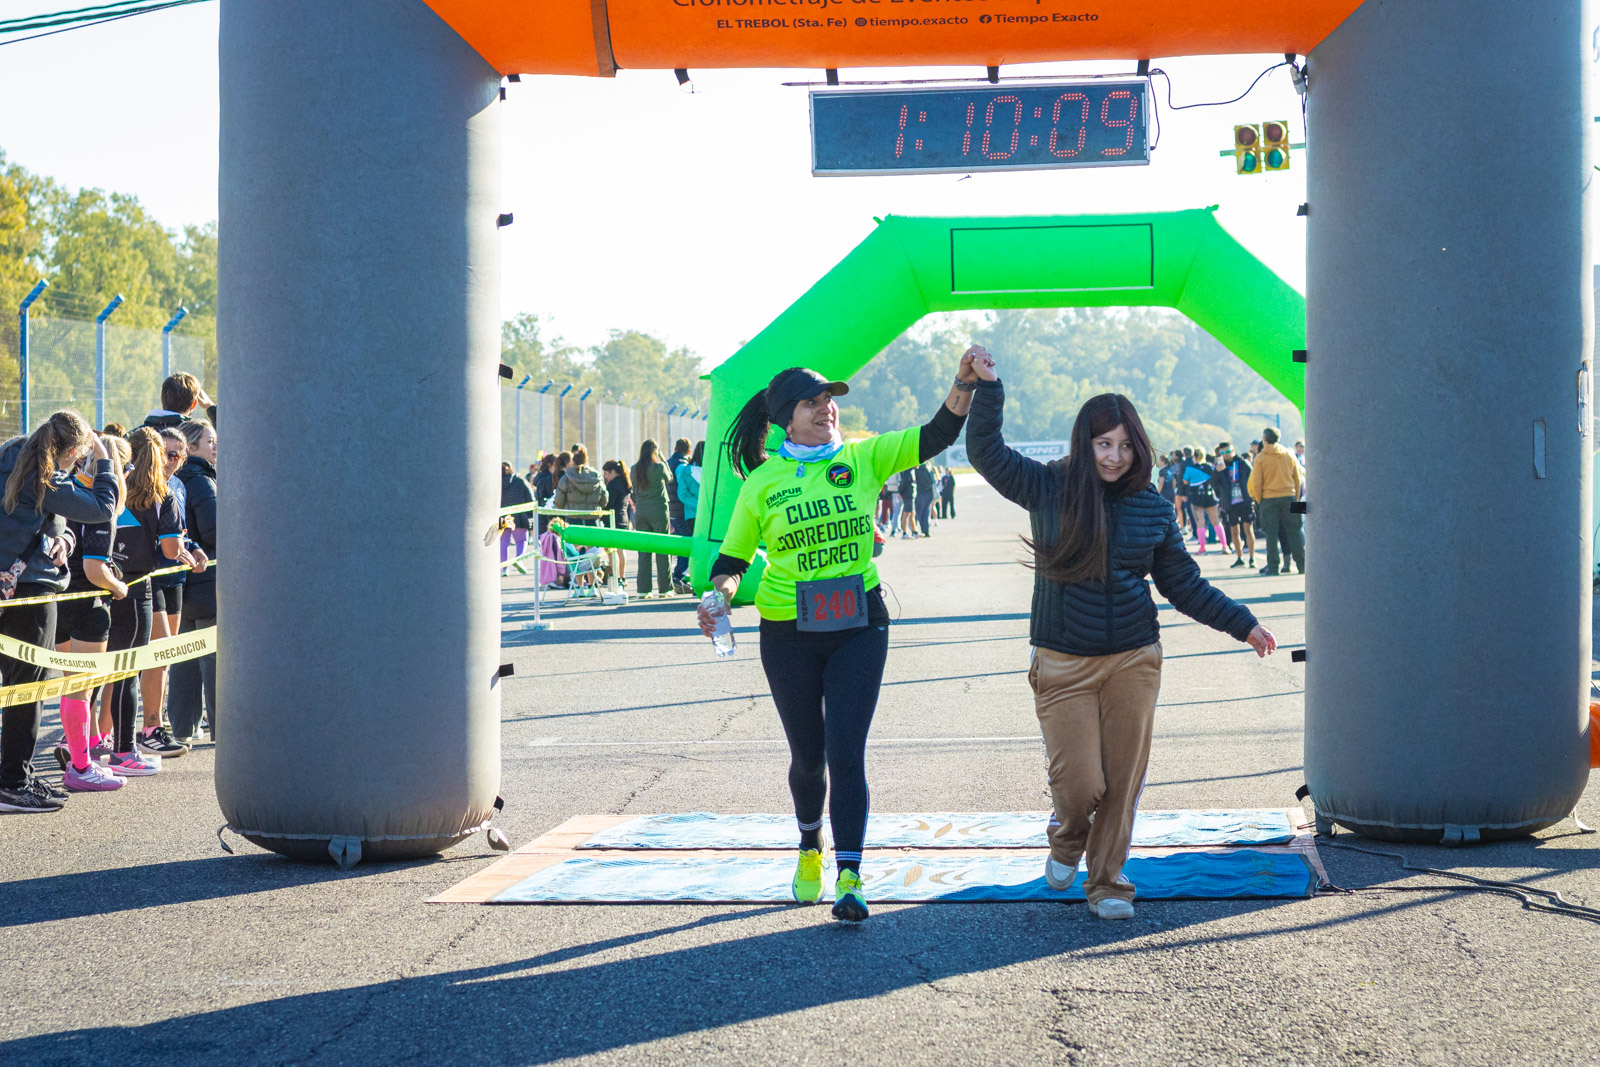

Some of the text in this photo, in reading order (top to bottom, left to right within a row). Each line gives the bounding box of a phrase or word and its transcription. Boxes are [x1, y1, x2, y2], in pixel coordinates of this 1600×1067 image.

[717, 12, 1099, 29] EL TREBOL (Sta. Fe) tiempo.exacto Tiempo Exacto
[765, 486, 802, 506] EMAPUR
[785, 498, 831, 525] CLUB
[832, 494, 857, 514] DE
[777, 514, 871, 552] CORREDORES
[797, 541, 859, 573] RECREO
[813, 589, 856, 621] 240
[49, 656, 97, 669] PRECAUCION
[154, 638, 207, 662] PRECAUCION
